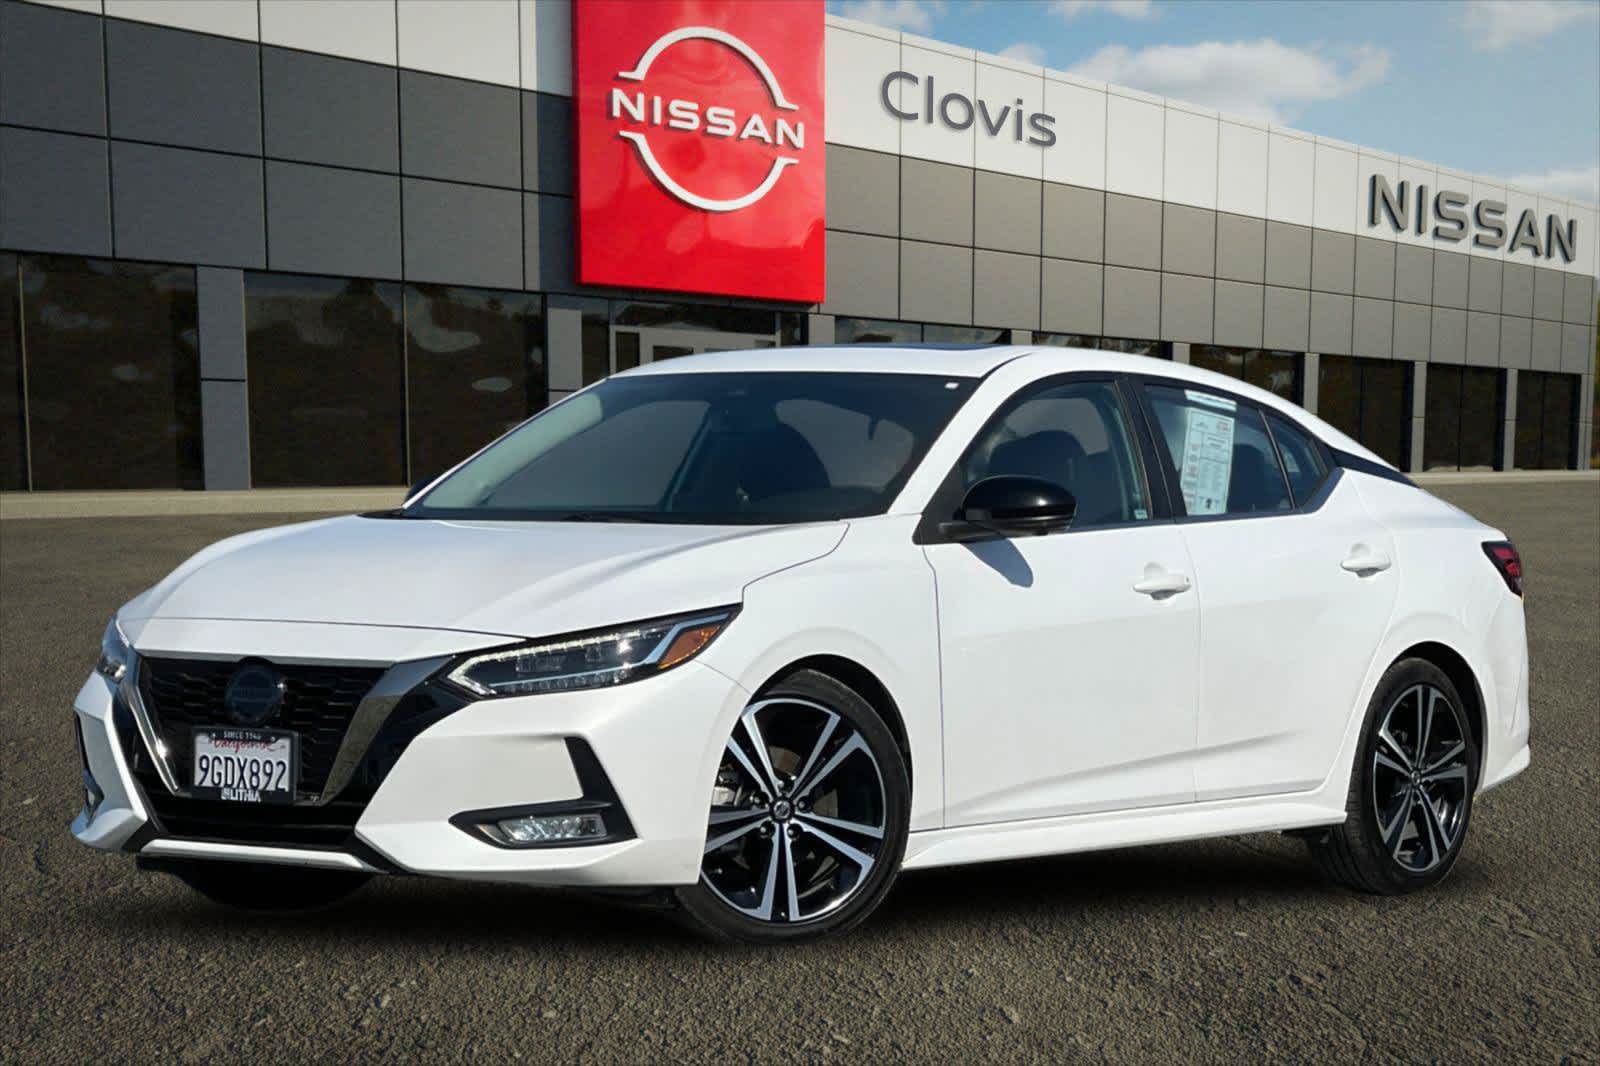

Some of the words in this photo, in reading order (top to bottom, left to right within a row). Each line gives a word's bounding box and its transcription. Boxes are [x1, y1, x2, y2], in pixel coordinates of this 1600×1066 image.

[611, 88, 805, 149] NISSAN
[881, 70, 1056, 147] Clovis
[1368, 174, 1577, 263] NISSAN
[199, 755, 287, 791] 9GDX892
